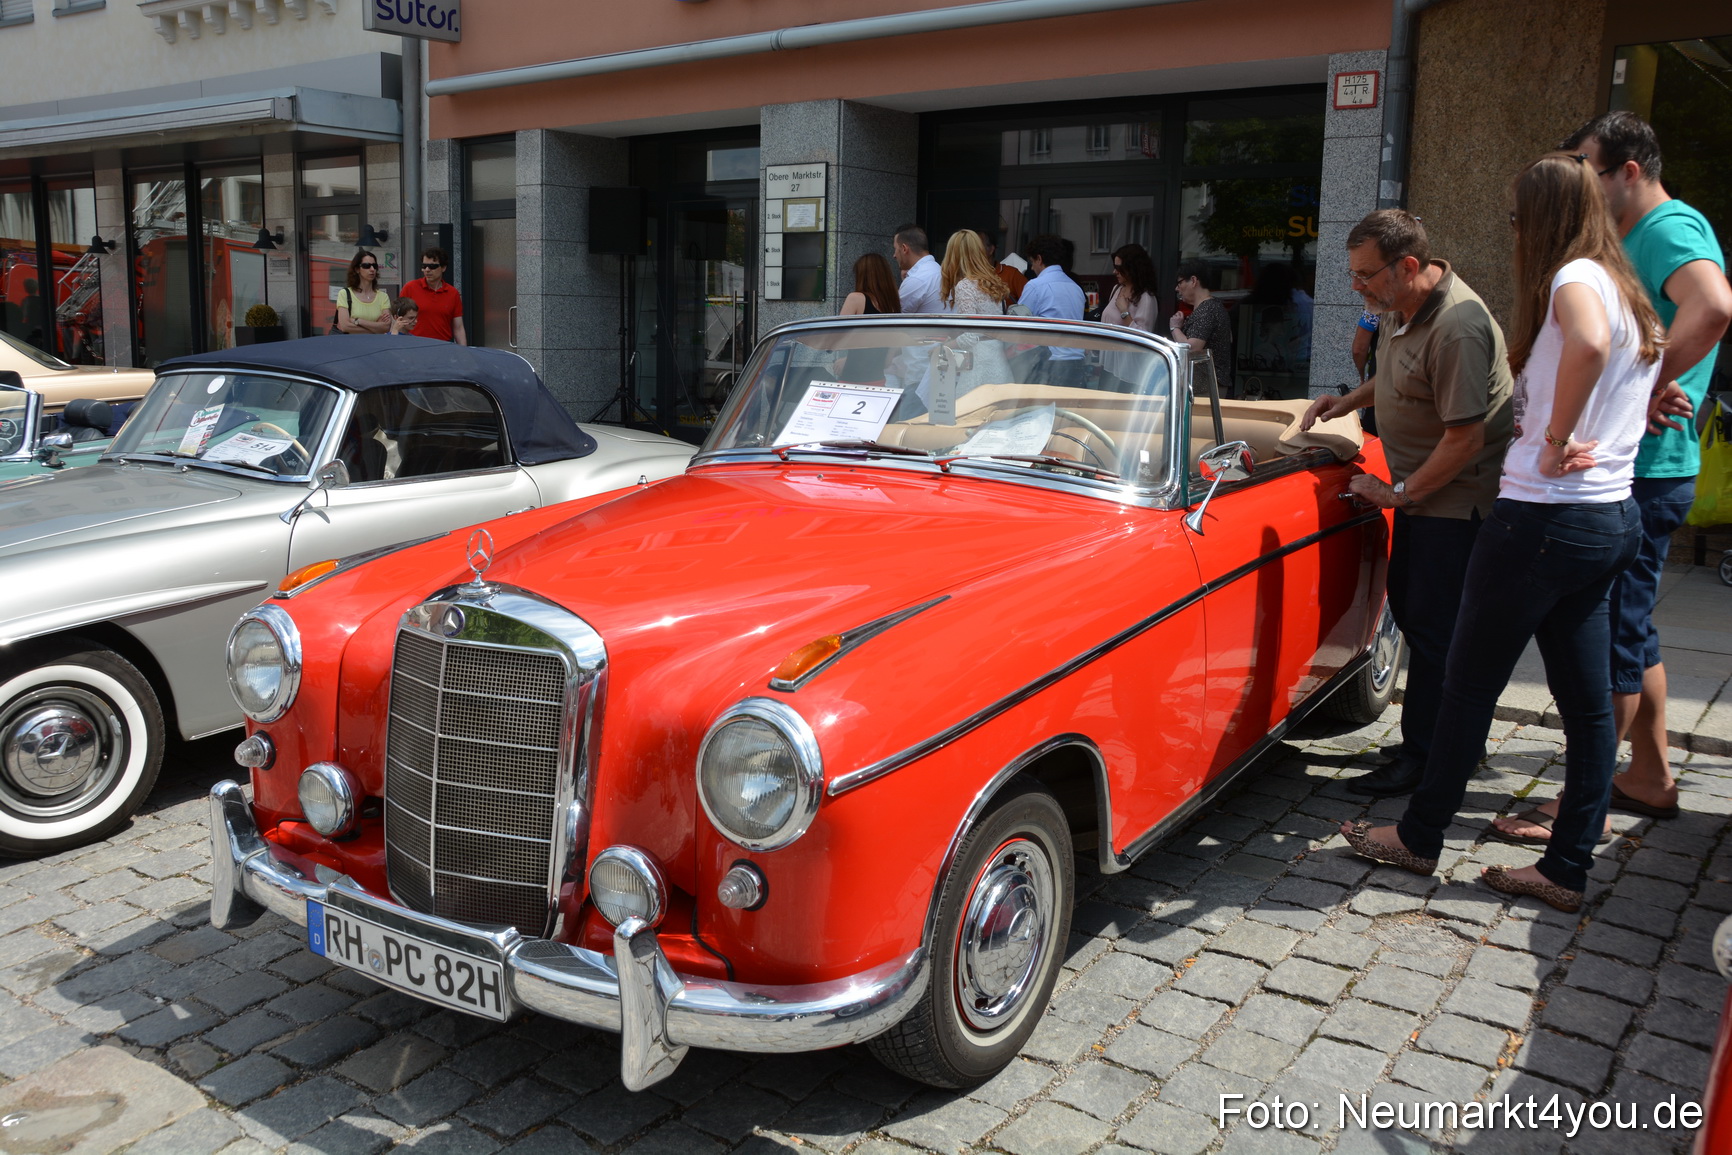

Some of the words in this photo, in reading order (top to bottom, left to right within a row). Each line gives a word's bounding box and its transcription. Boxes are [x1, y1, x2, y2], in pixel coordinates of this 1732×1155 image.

[768, 172, 789, 181] Obere
[792, 171, 824, 180] Marktstr.
[791, 183, 800, 192] 27
[1242, 225, 1274, 238] Schuhe
[1275, 225, 1286, 240] by
[851, 400, 867, 415] 2
[314, 932, 321, 945] D
[325, 913, 364, 965] RH
[382, 935, 425, 986] PC
[434, 953, 502, 1013] 82H
